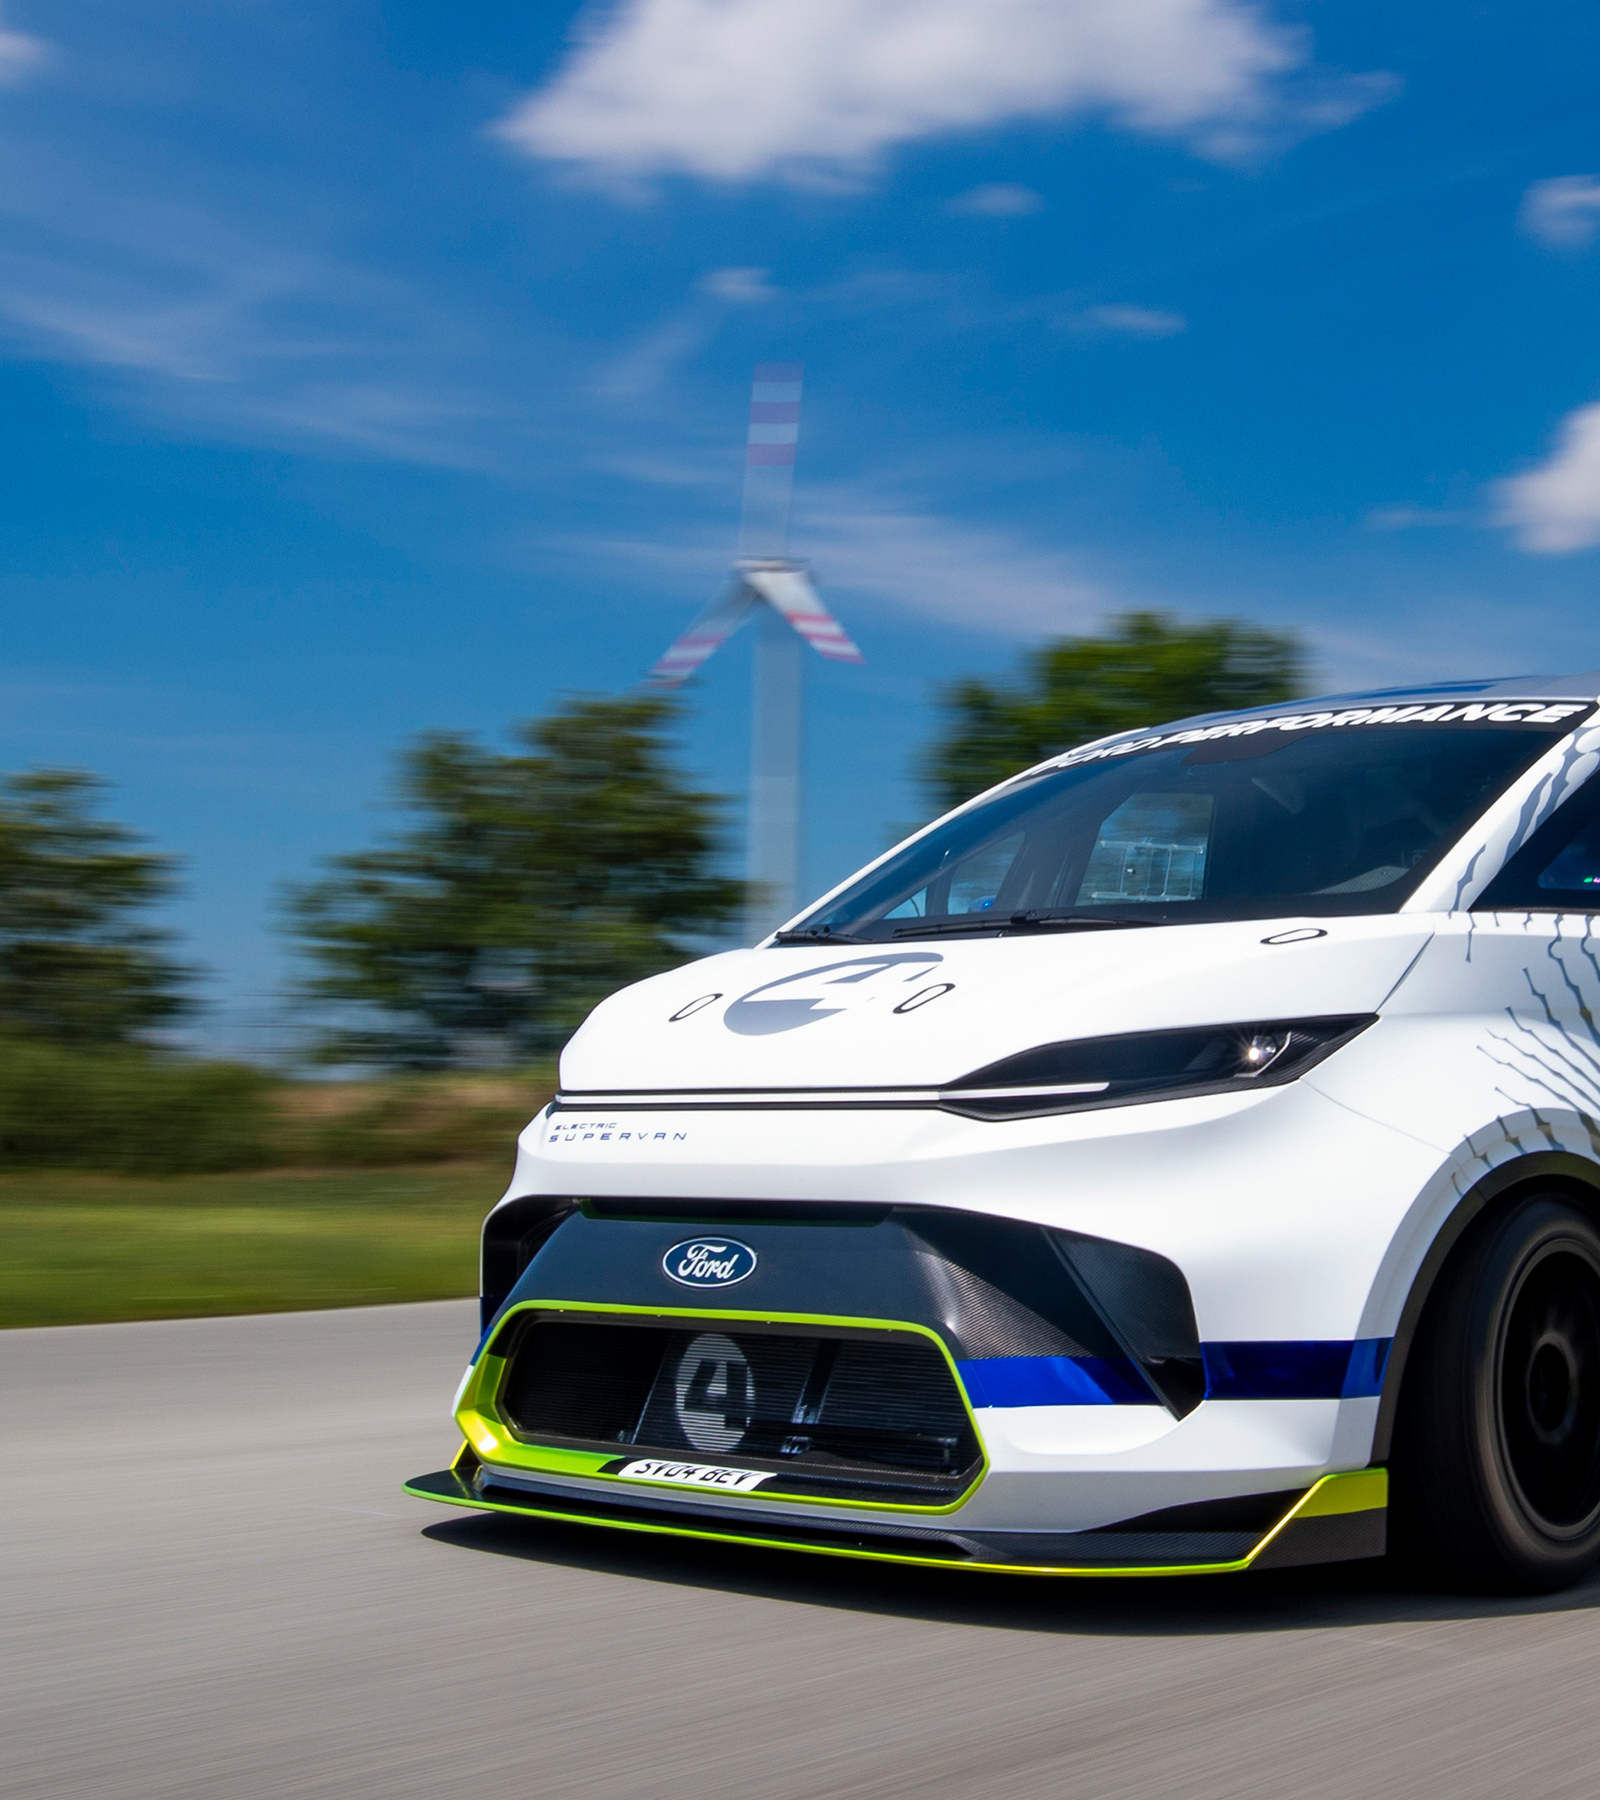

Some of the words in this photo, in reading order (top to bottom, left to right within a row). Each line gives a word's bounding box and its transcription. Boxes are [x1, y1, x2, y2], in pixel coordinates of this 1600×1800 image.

[1147, 702, 1588, 749] PERFORMANCE
[554, 1122, 618, 1131] ELECTRIC
[548, 1132, 688, 1143] SUPERVAN
[677, 1242, 740, 1280] Ford
[698, 1468, 761, 1486] BEV
